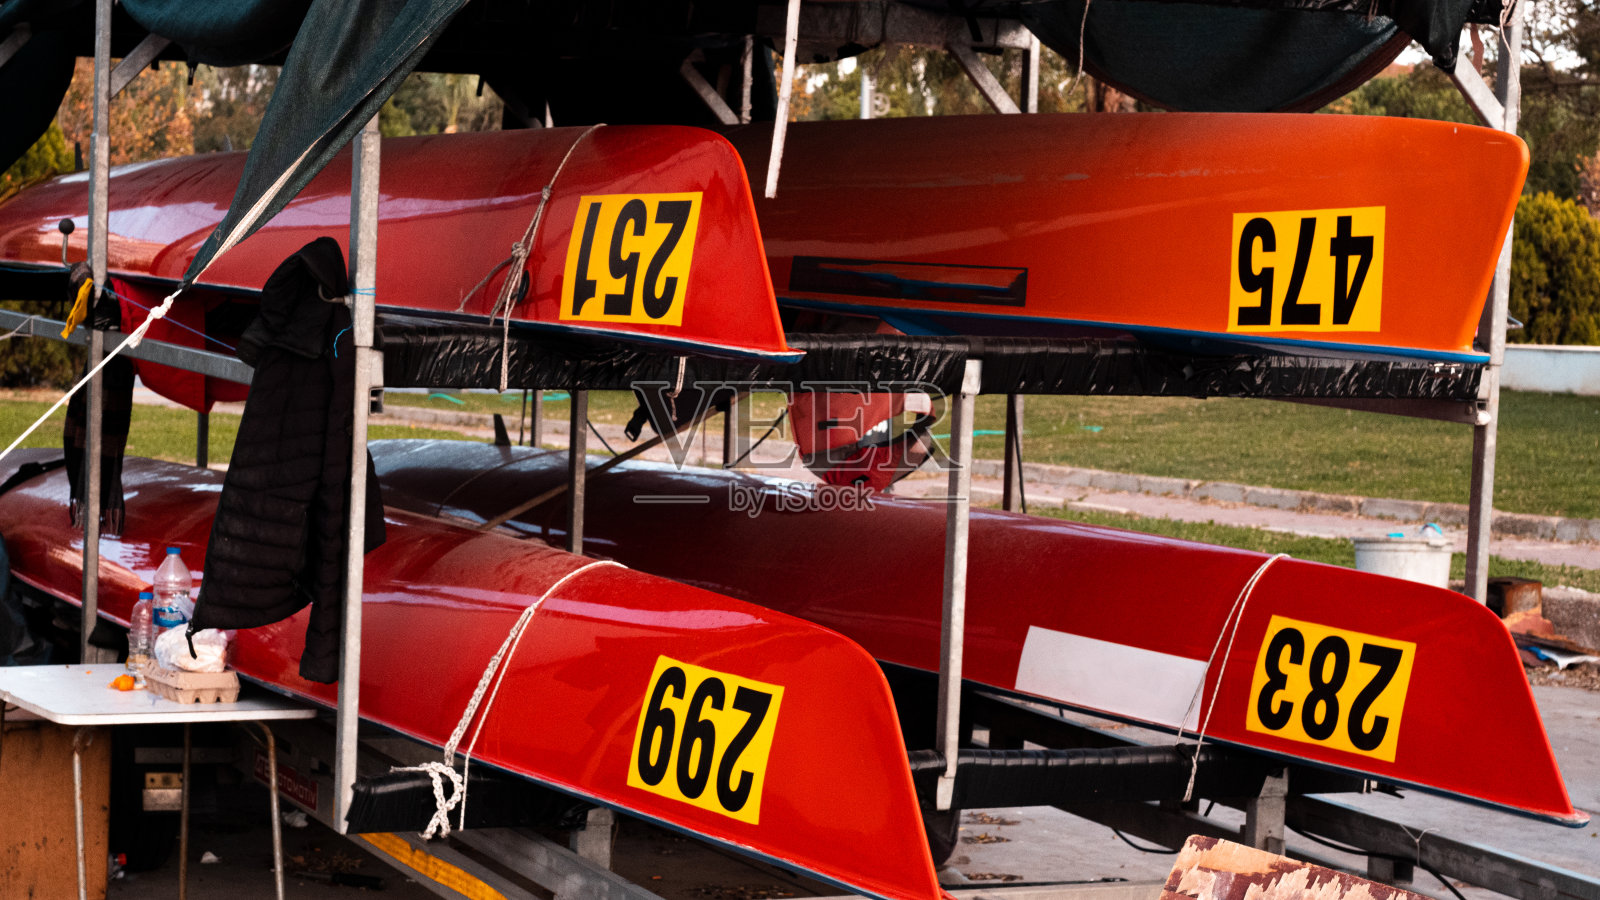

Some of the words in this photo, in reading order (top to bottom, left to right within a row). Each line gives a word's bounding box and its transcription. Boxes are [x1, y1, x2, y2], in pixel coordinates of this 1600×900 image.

[572, 199, 692, 319] 251
[1237, 215, 1374, 326] 475
[638, 666, 773, 812] 299
[1257, 627, 1403, 751] 283
